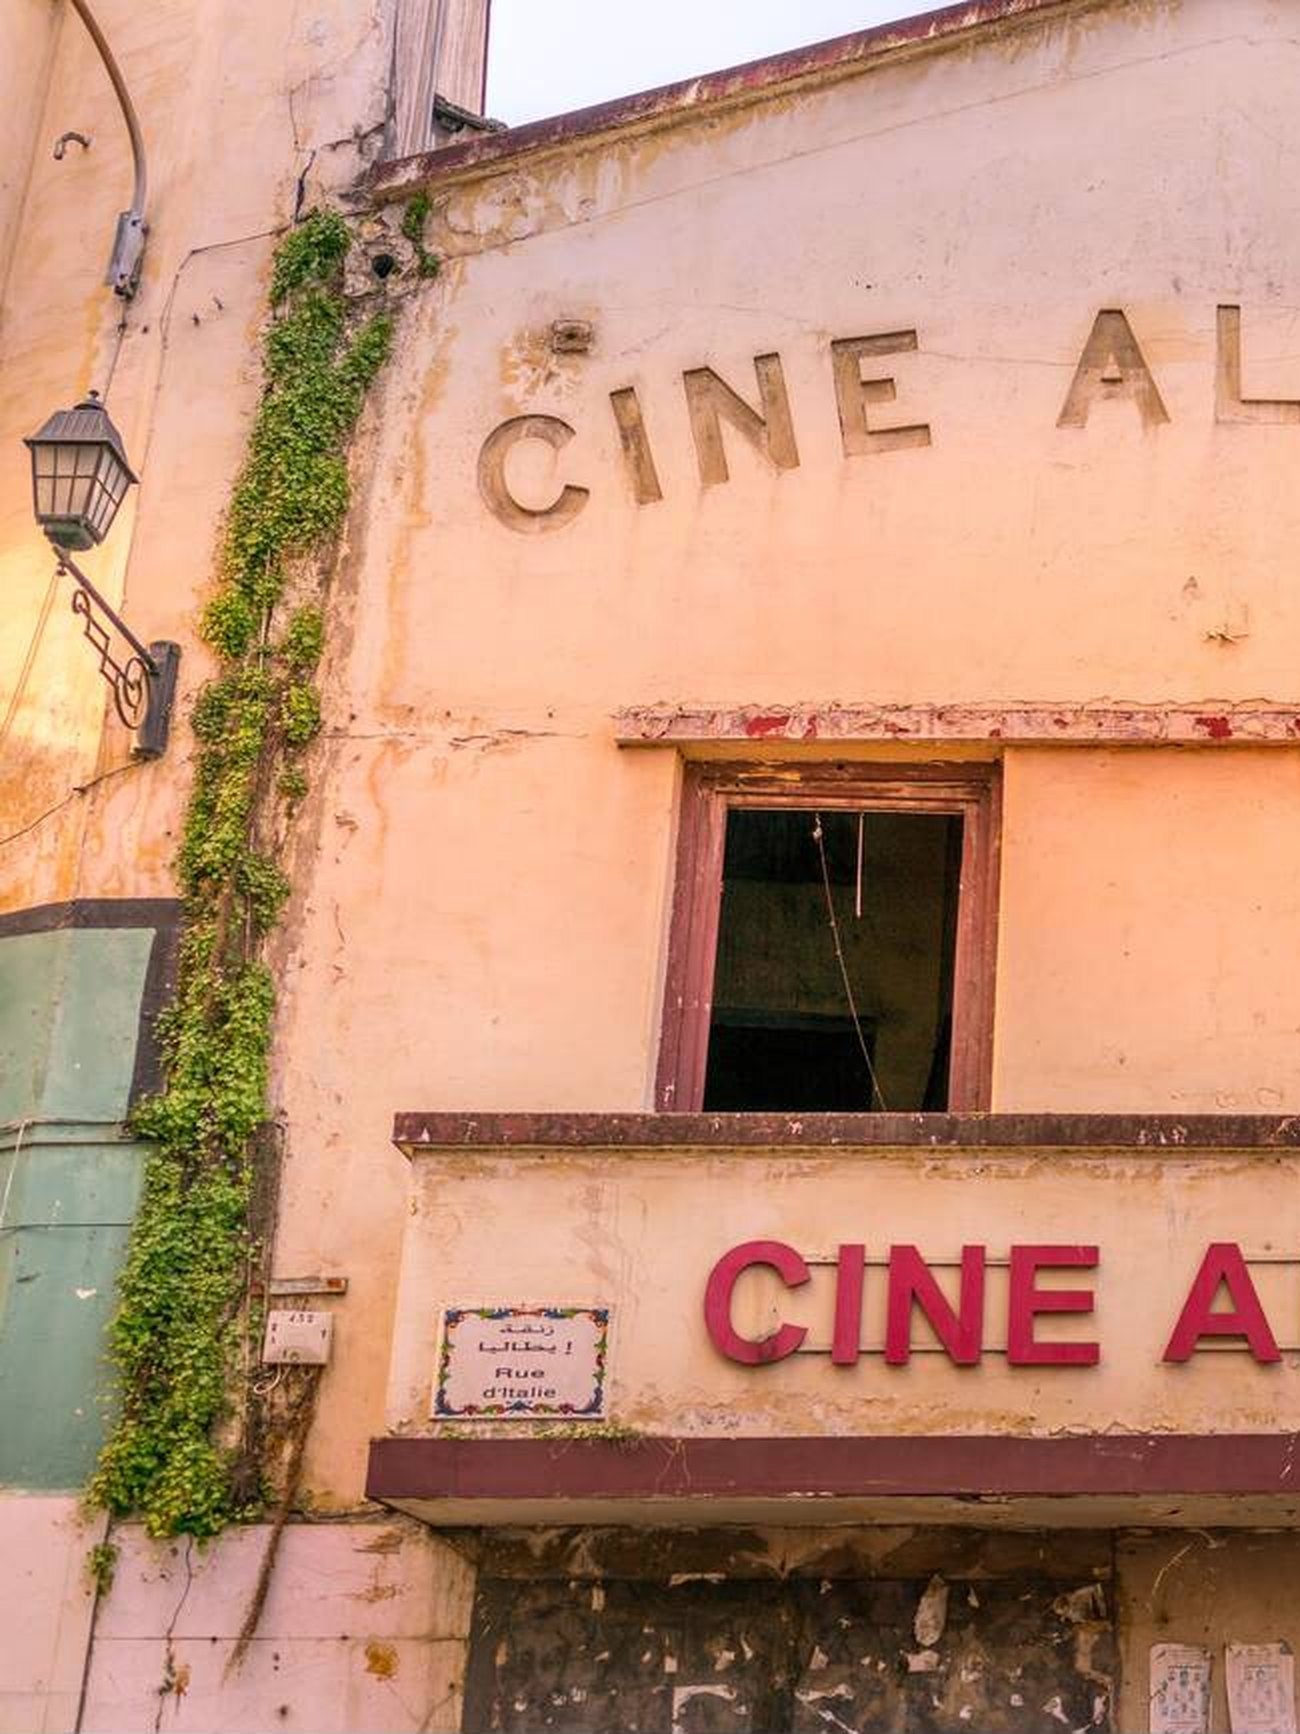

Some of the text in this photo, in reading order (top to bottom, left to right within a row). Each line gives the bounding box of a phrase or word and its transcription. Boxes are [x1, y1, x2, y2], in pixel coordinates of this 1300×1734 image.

[477, 329, 931, 534] CINE
[704, 1240, 1100, 1365] CINE
[482, 1386, 557, 1399] d'Italie
[495, 1367, 545, 1379] Rue
